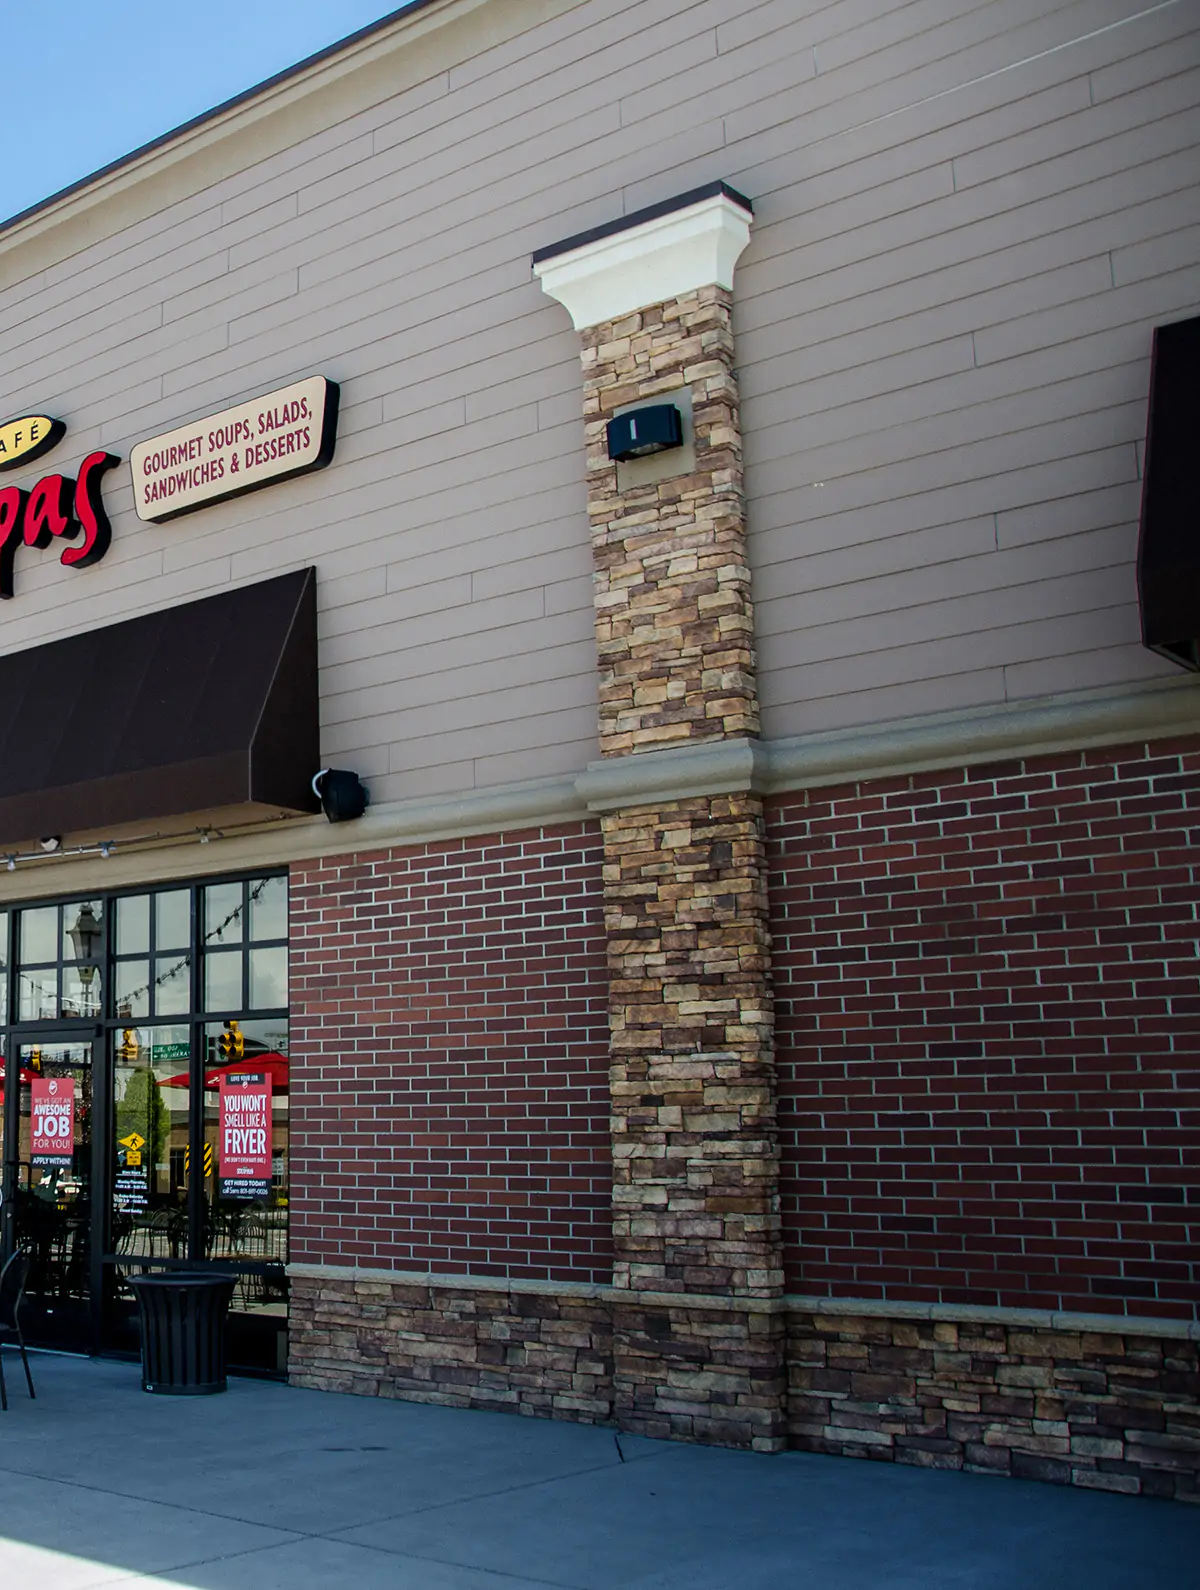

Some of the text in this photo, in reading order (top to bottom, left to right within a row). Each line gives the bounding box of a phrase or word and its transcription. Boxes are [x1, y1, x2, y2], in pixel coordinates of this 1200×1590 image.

[143, 397, 313, 476] GOURMET SOUPS, SALADS,
[144, 426, 311, 504] SANDWICHES & DESSERTS
[33, 1104, 71, 1116] AWESOME
[223, 1095, 240, 1112] YOU
[33, 1116, 70, 1137] JOB
[224, 1113, 267, 1128] SMELL LIKE A
[33, 1138, 70, 1149] FOR YOU!
[224, 1128, 267, 1155] FRYER
[32, 1156, 48, 1164] APPLY
